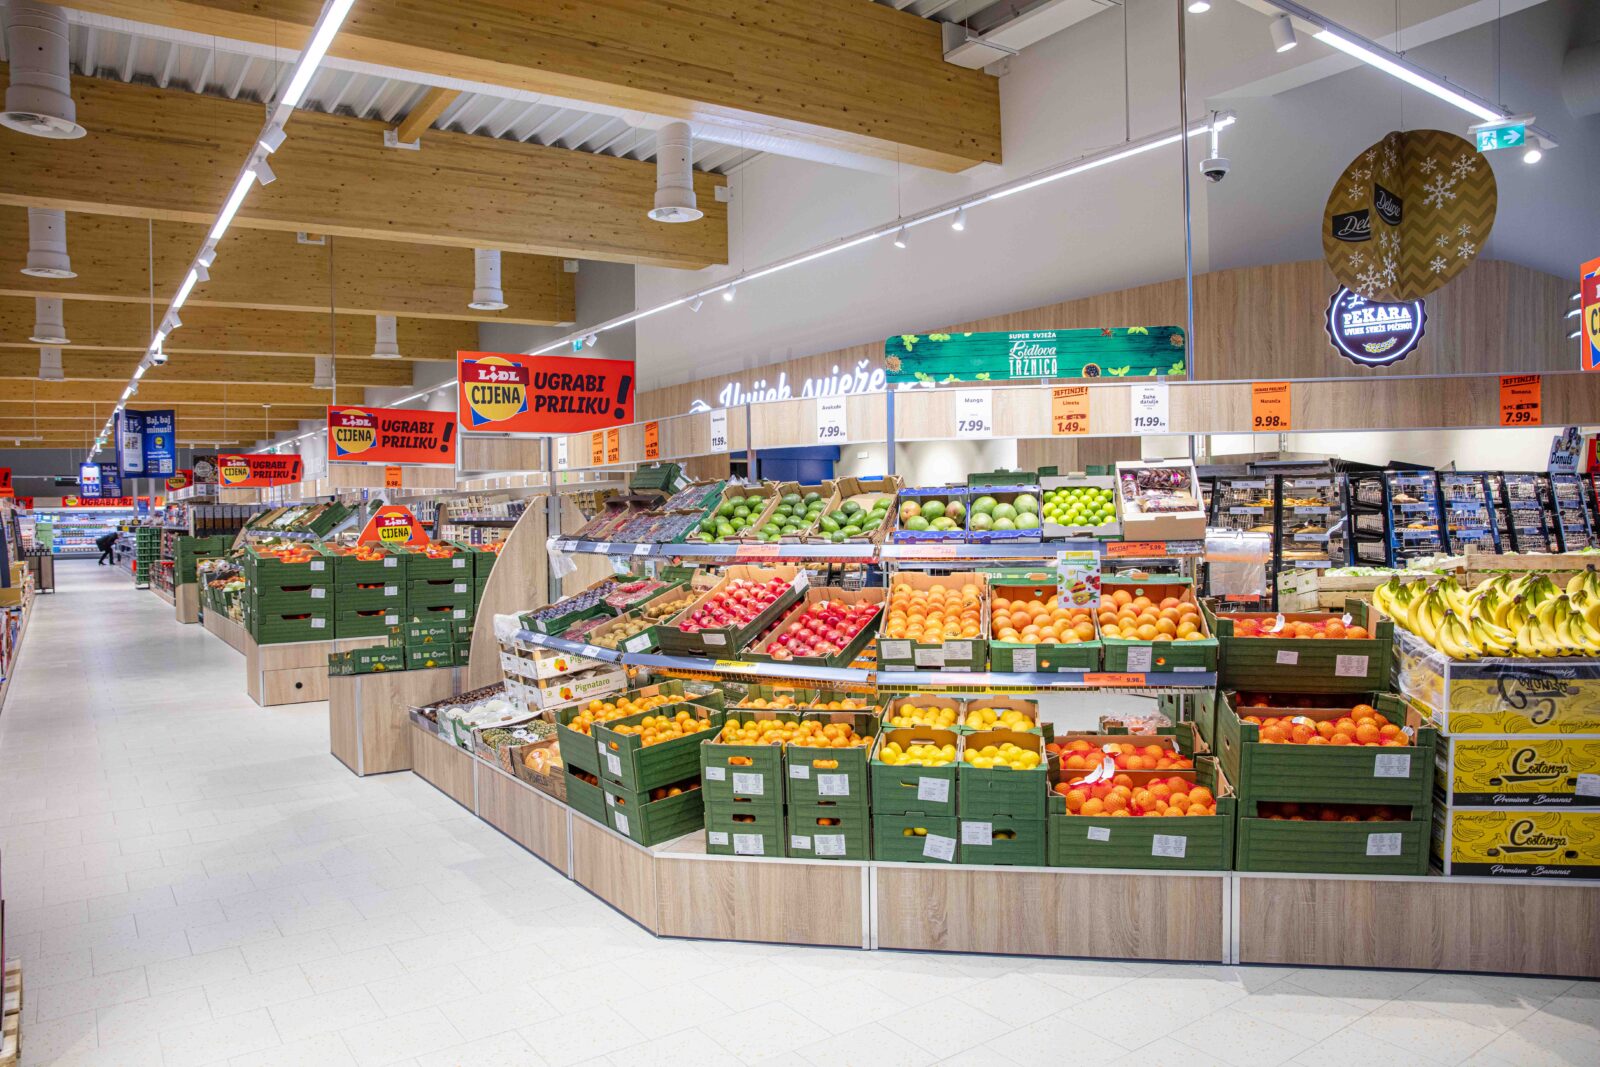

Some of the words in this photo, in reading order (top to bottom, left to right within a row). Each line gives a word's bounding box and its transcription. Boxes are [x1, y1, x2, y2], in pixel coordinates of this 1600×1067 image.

[1376, 190, 1401, 217] Deluxe
[1343, 306, 1411, 325] PEKARA
[1032, 331, 1057, 339] SVJEŽA
[1009, 340, 1057, 360] Lidlova
[1008, 357, 1058, 376] TRŽNICA
[534, 372, 607, 393] UGRABI
[471, 385, 521, 405] CIJENA
[534, 395, 611, 415] PRILIKU
[1134, 416, 1160, 427] 11.99
[1254, 415, 1280, 427] 9.98
[1505, 411, 1531, 423] 7.99
[381, 420, 434, 434] UGRABI
[819, 425, 840, 438] 7.99
[958, 420, 983, 432] 7.99
[1057, 421, 1079, 433] 1.49
[336, 428, 372, 442] CIJENA
[381, 435, 437, 449] PRILIKU
[1550, 452, 1573, 465] Donuts
[224, 467, 248, 477] CIJENA
[252, 461, 287, 470] UGRABI
[253, 470, 290, 479] PRILIKU
[381, 528, 409, 538] CIJENA
[575, 678, 610, 693] Pignataro
[1512, 748, 1568, 776] Costanza
[1492, 794, 1530, 804] Premium
[1533, 794, 1573, 805] Bananas
[1510, 820, 1567, 847] Costanza
[1490, 864, 1528, 874] Premium
[1531, 865, 1571, 876] Bananas
